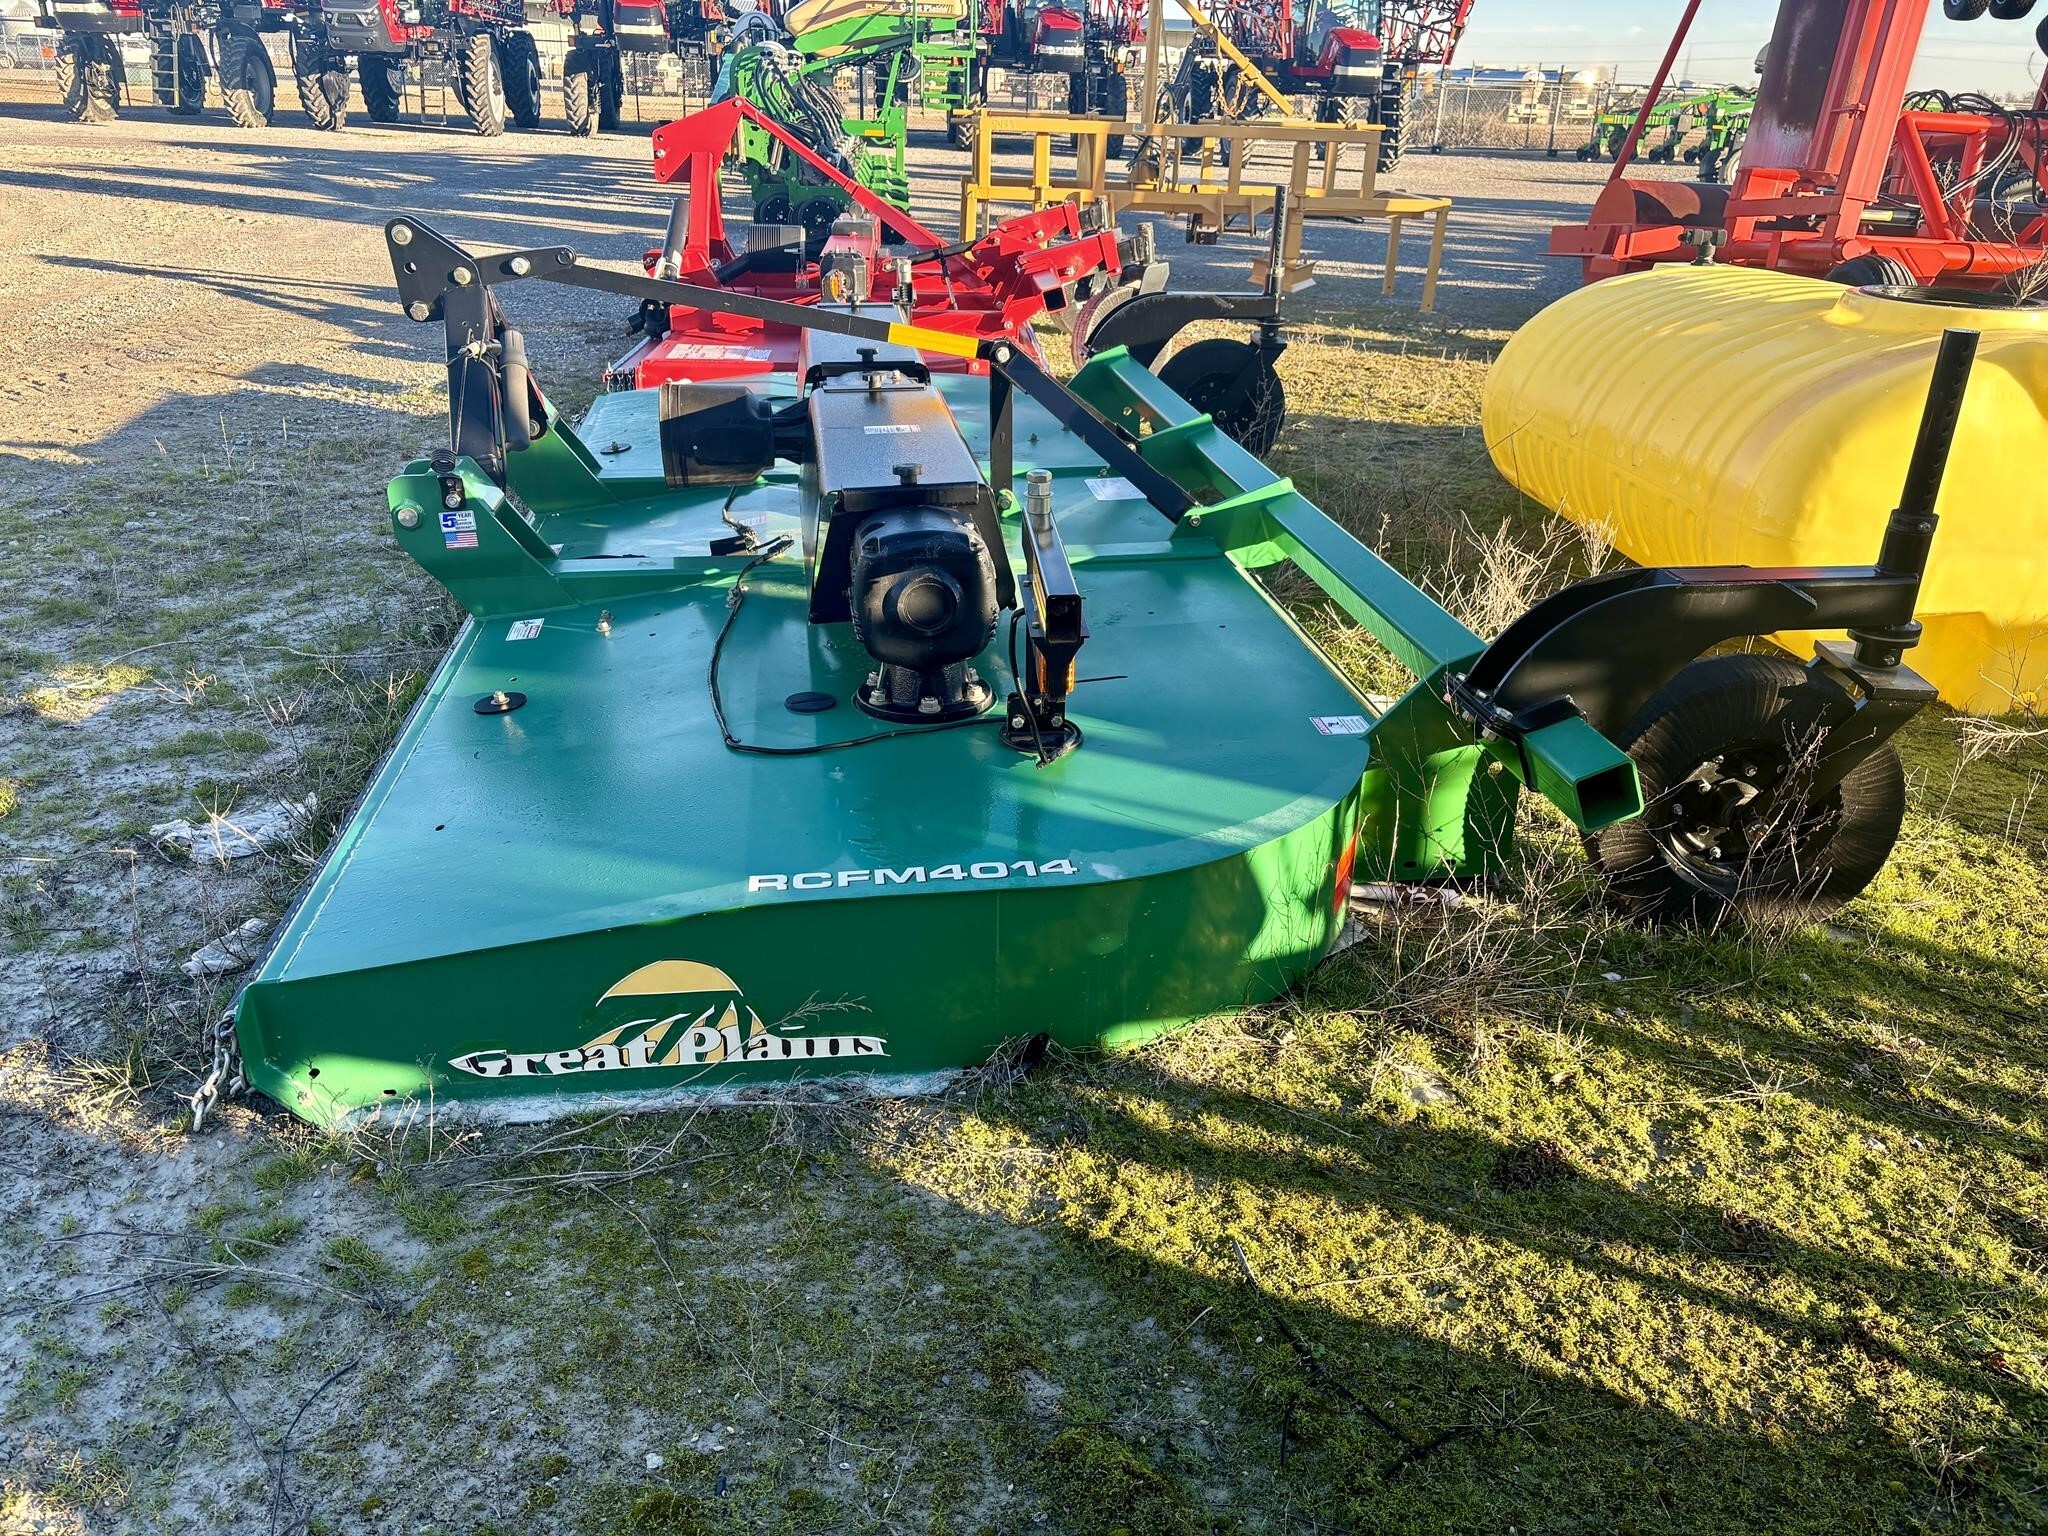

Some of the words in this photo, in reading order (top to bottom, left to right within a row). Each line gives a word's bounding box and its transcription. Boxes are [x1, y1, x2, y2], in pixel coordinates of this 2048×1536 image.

[442, 513, 457, 528] 5
[747, 858, 1079, 892] RCFM4014
[448, 1024, 660, 1078] Great
[676, 1012, 891, 1065] Plains
